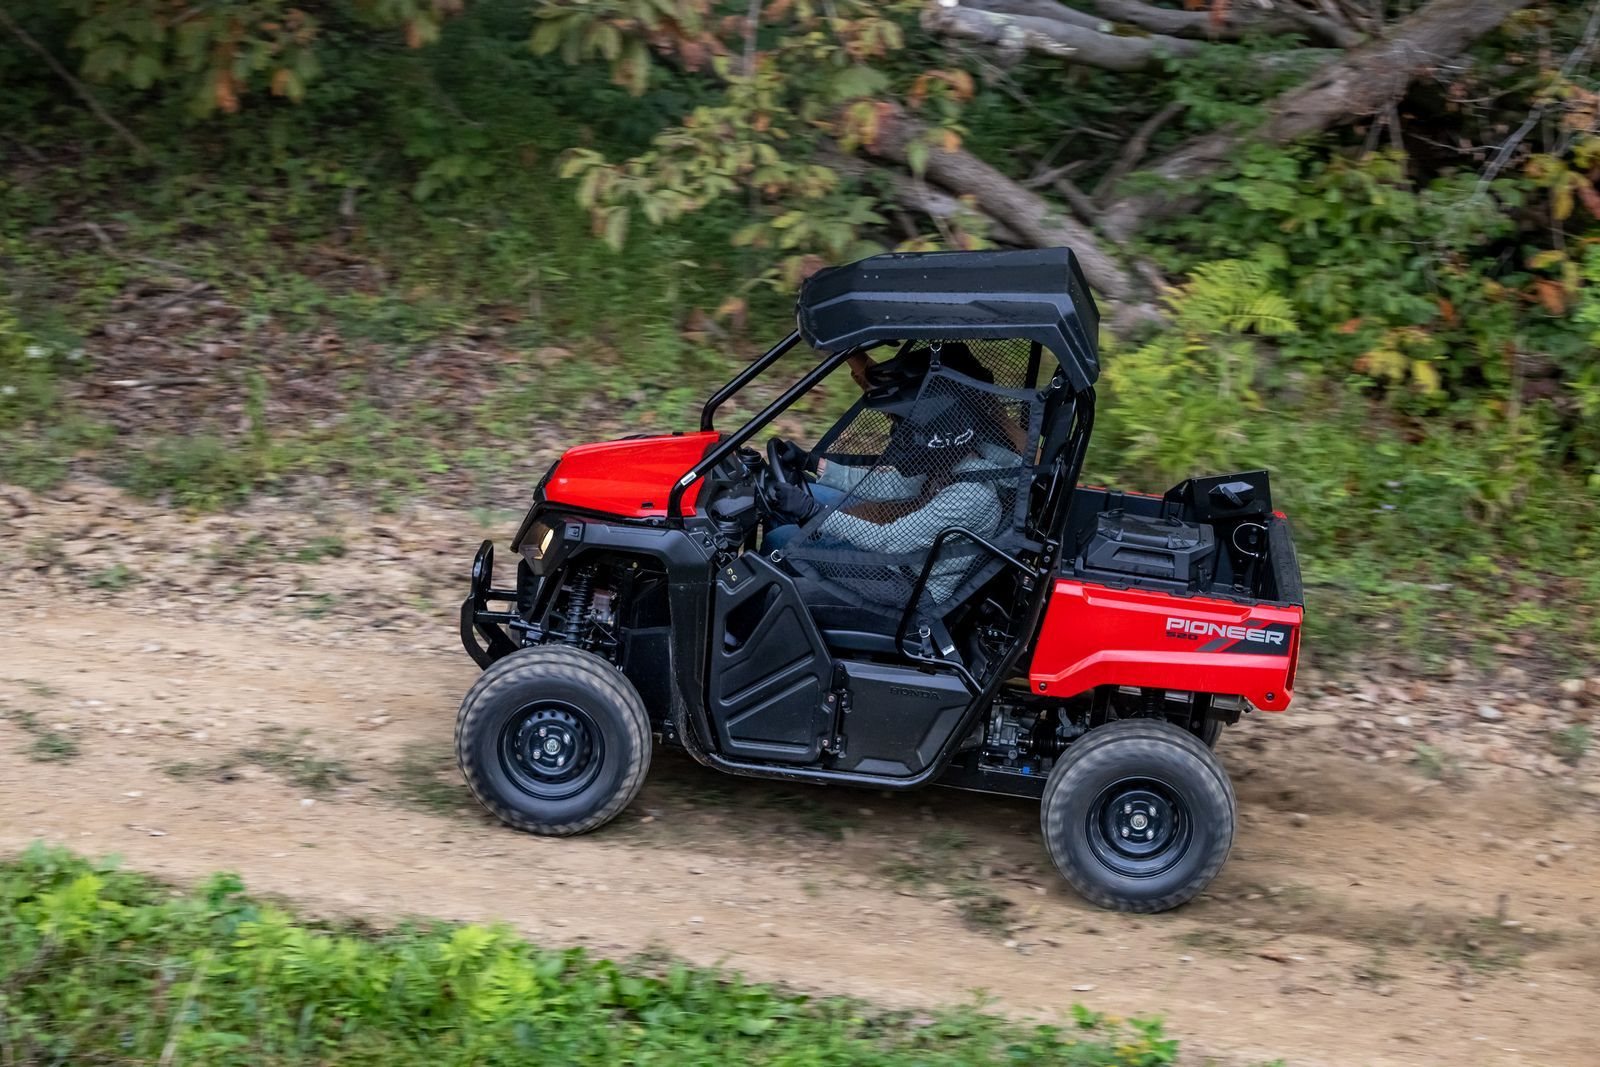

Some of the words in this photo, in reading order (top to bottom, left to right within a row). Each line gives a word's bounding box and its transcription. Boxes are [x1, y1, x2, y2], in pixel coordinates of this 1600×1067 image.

[1166, 617, 1285, 645] PIONEER
[1166, 631, 1198, 641] 520
[889, 686, 941, 701] HONDA
